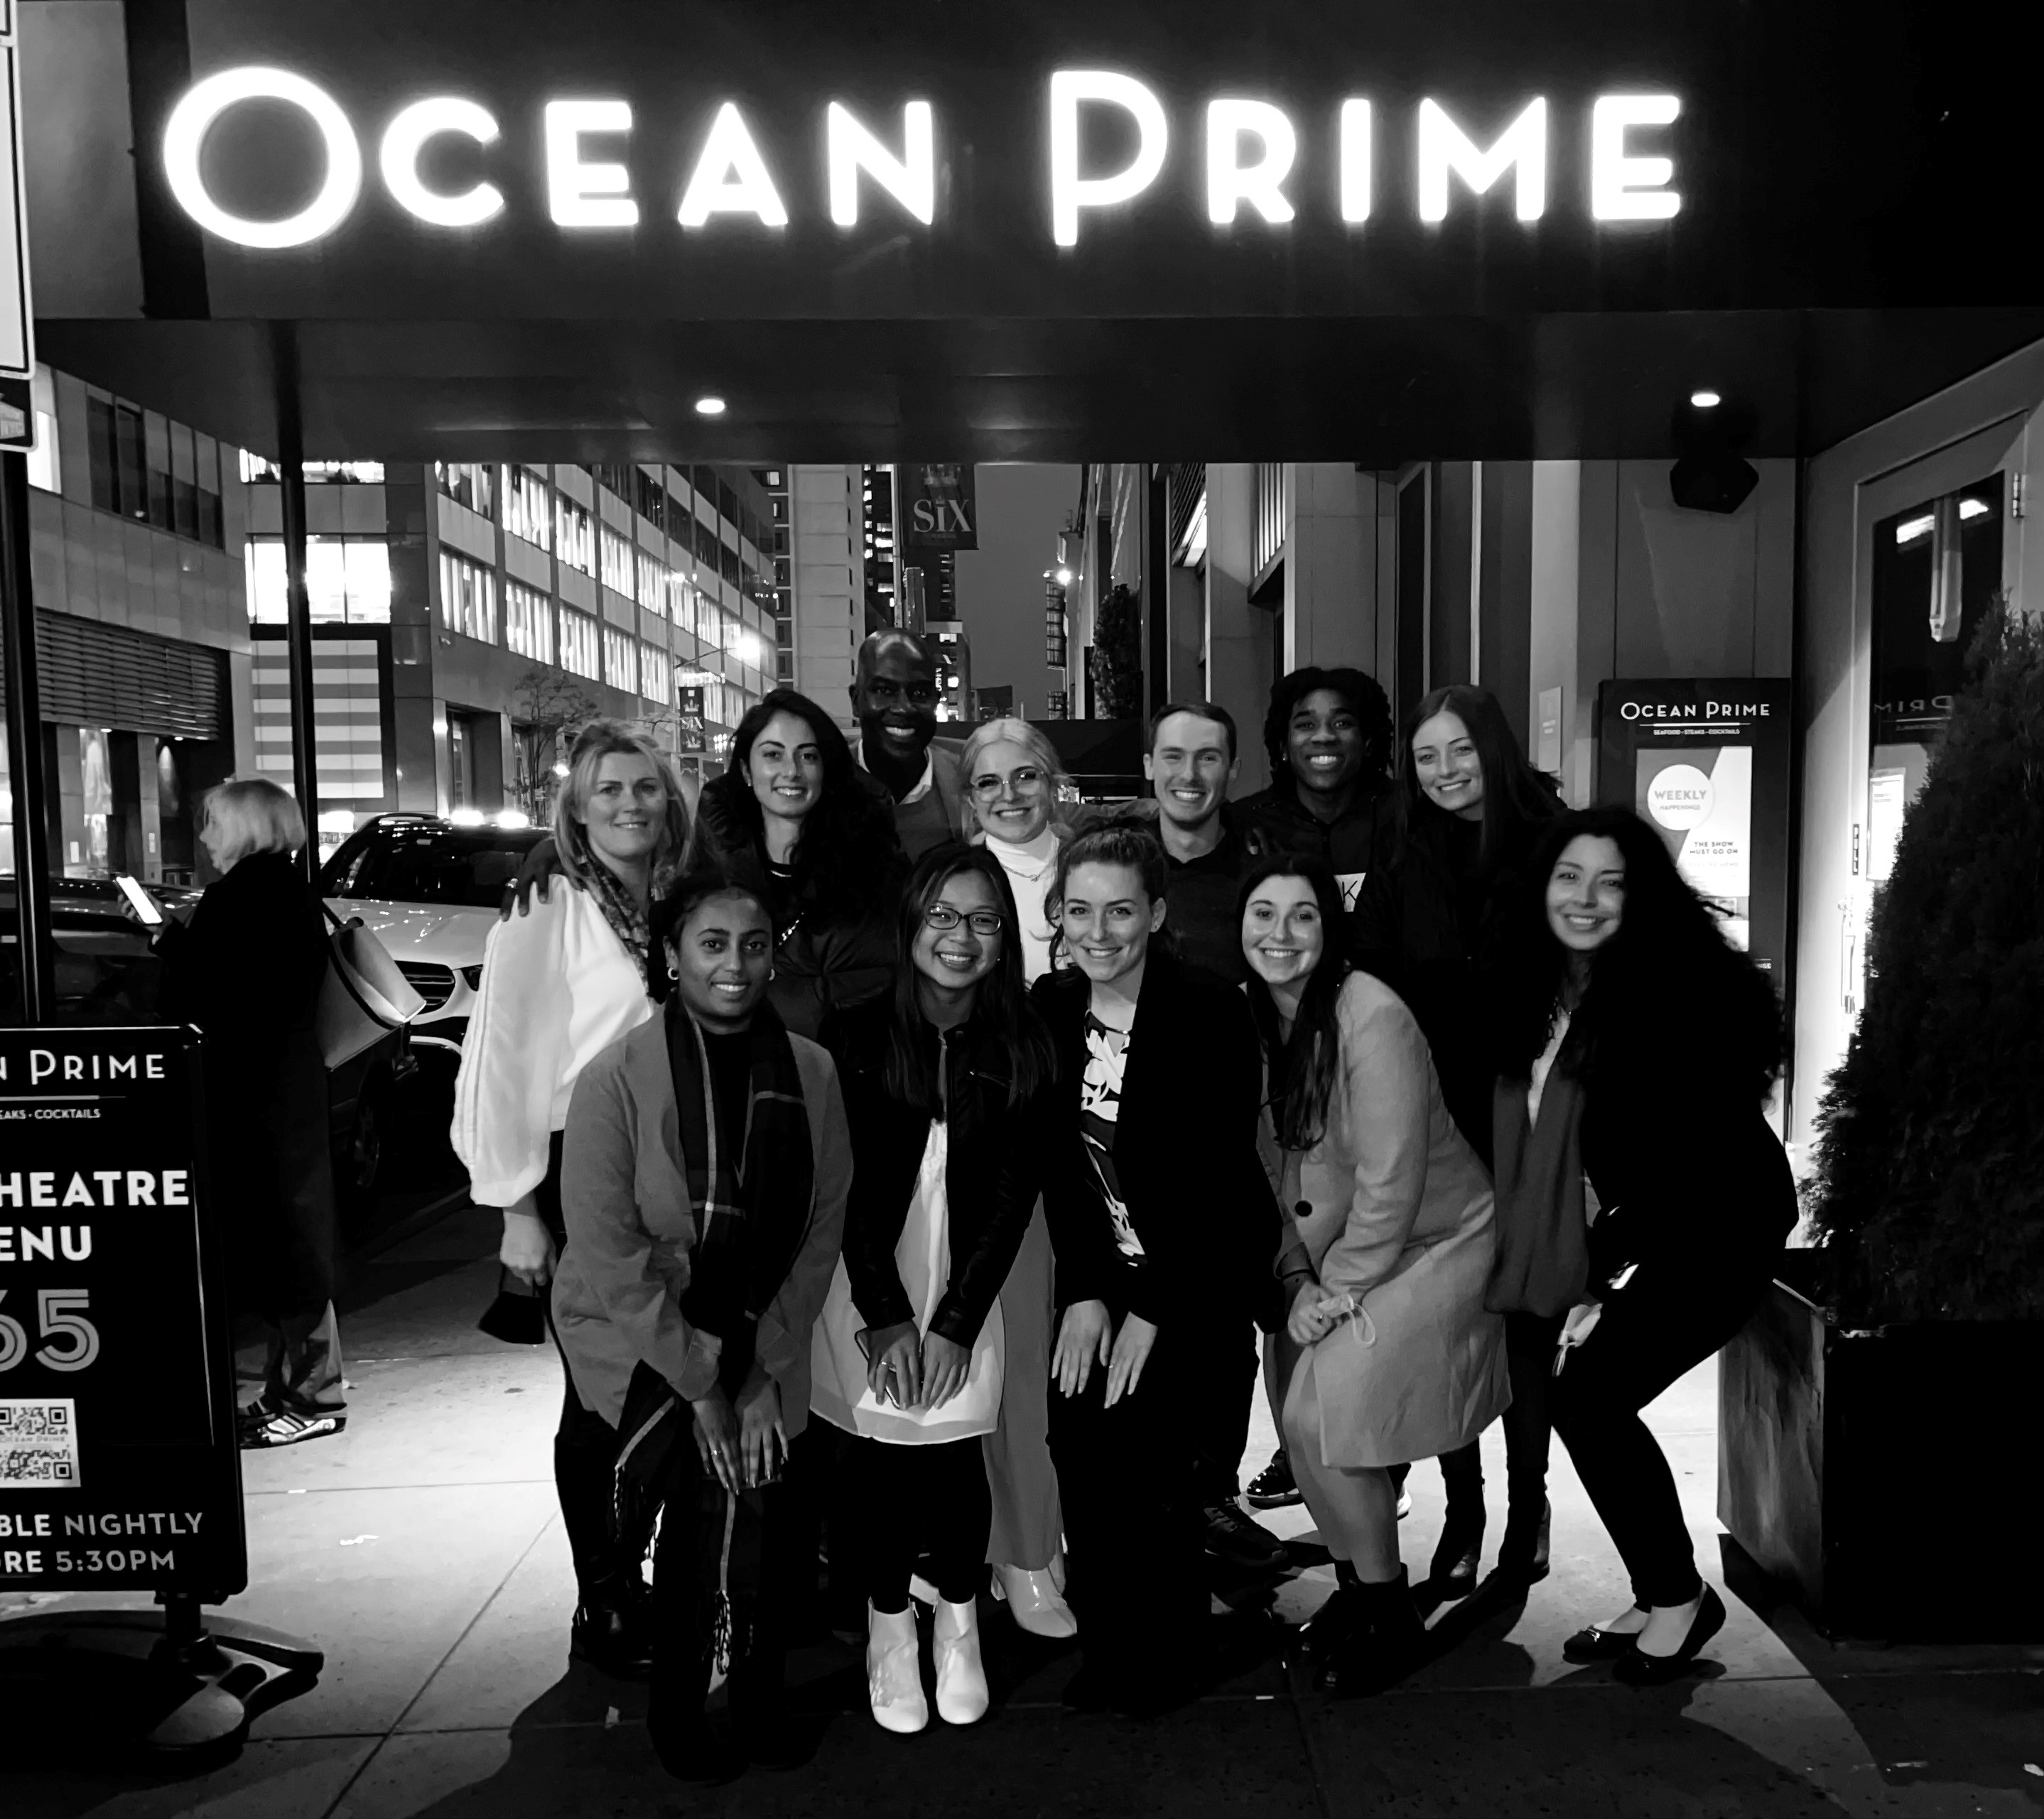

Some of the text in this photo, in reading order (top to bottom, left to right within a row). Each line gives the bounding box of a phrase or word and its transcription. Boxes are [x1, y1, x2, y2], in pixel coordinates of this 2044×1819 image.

[163, 67, 1681, 249] OCEAN PRIME
[1621, 701, 1770, 720] OCEAN PRIME
[1654, 790, 1707, 800] WEEKLY
[31, 1049, 166, 1085] PRIME
[34, 1108, 101, 1120] COCKTAILS
[0, 1170, 190, 1207] HEATRE
[0, 1225, 92, 1261] ENU
[0, 1512, 202, 1537] BLE NIGHTLY
[56, 1550, 175, 1572] 5:30PM
